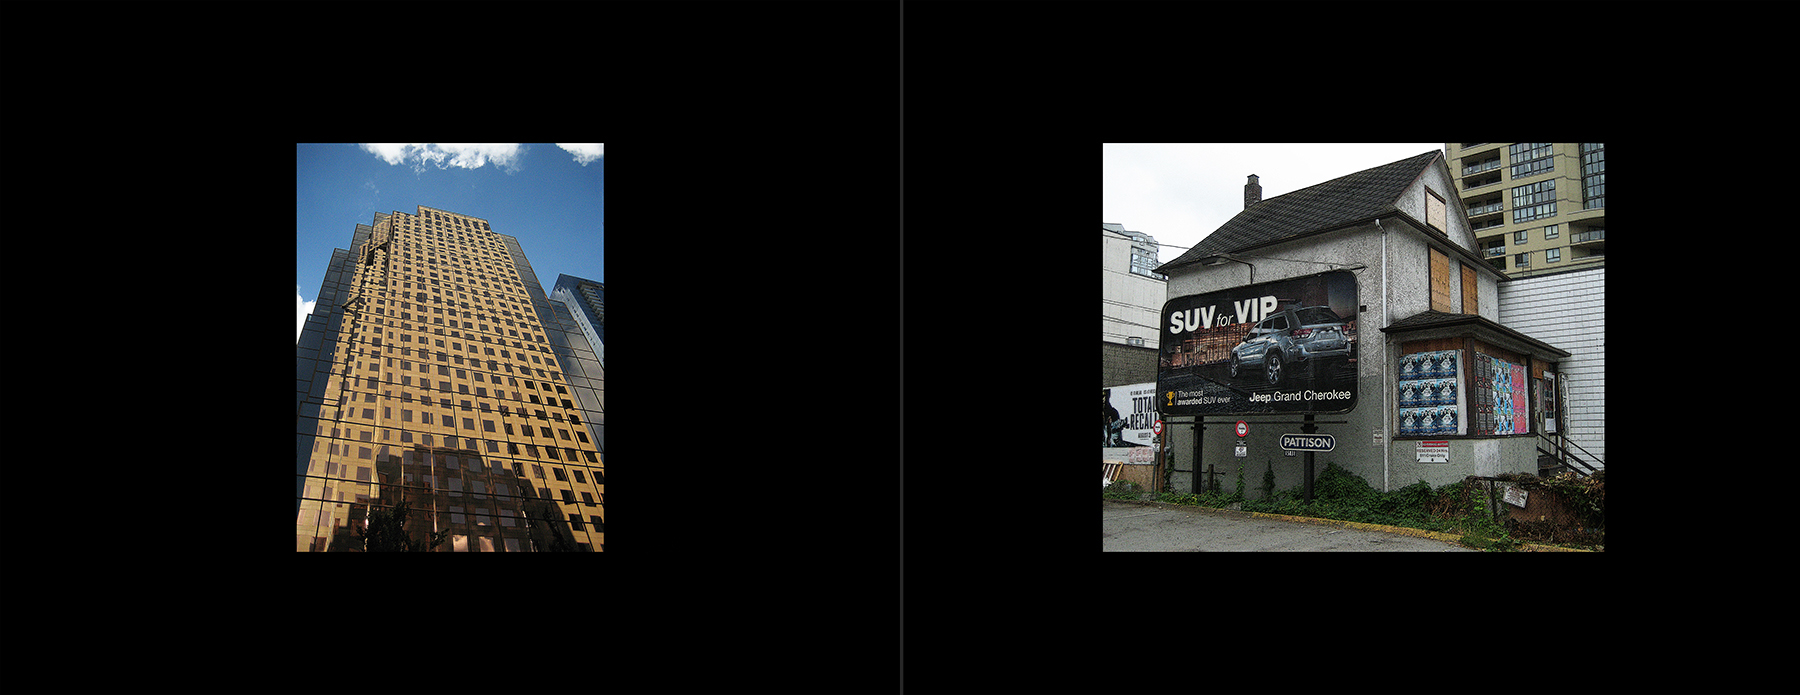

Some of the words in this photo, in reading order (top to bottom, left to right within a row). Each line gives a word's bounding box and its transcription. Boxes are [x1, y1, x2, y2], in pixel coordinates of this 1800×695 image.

[1170, 305, 1216, 334] SUV
[1216, 313, 1234, 328] for
[1234, 295, 1278, 324] VIP
[1178, 390, 1188, 398] The
[1249, 392, 1271, 403] Jeep
[1273, 391, 1301, 401] Grand
[1303, 389, 1351, 401] Cherokee
[1132, 396, 1157, 413] TOTAL
[1177, 397, 1202, 406] awarded
[1203, 396, 1217, 404] SUV
[1284, 437, 1331, 448] PATTISON
